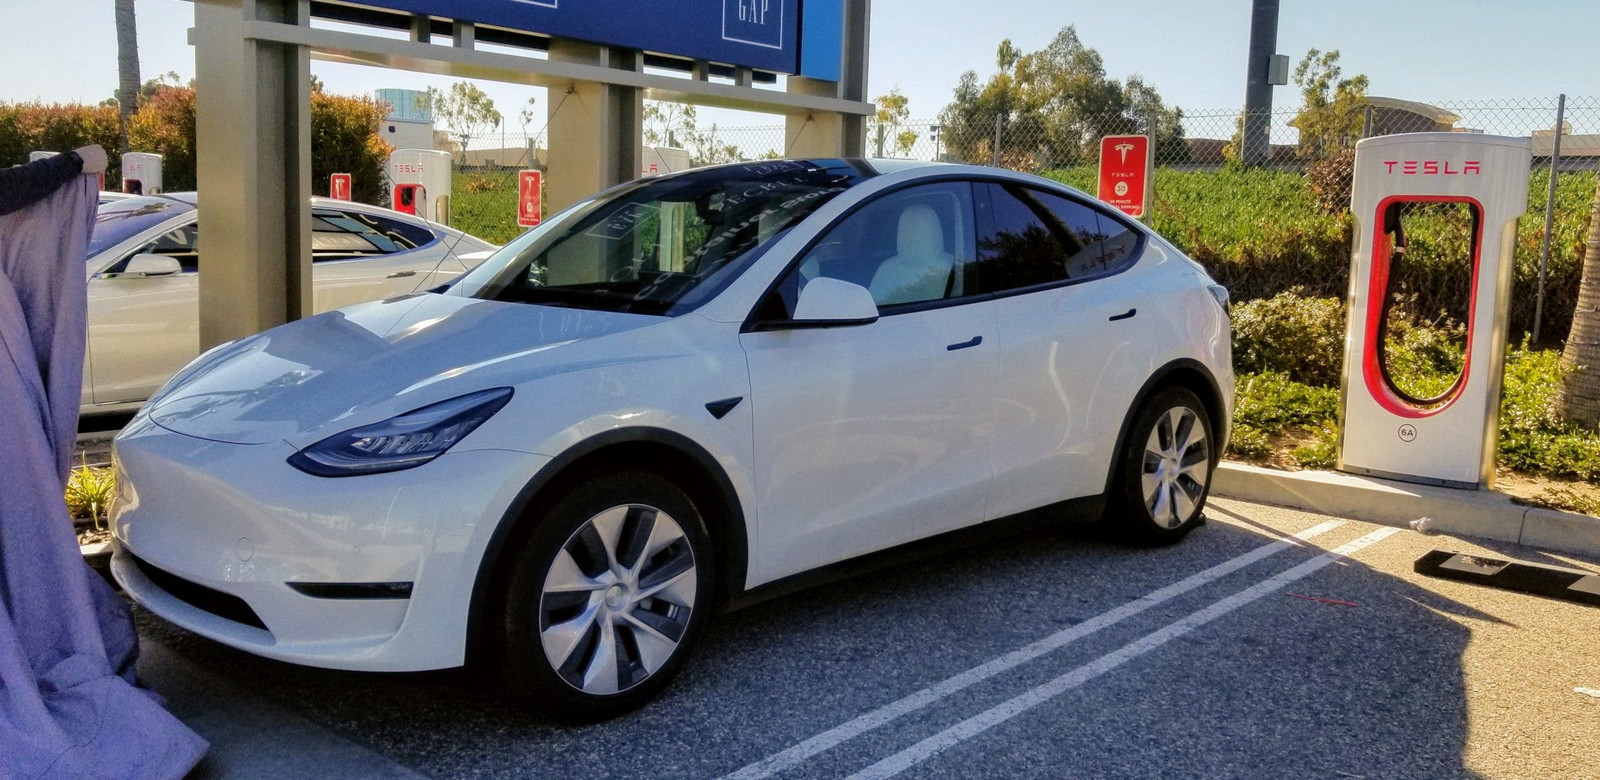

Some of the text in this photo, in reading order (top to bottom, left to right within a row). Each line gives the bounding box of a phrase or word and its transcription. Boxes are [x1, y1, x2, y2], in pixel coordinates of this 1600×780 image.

[739, 0, 768, 24] GAP
[395, 164, 423, 172] TESLA
[1384, 161, 1480, 174] TESLA
[1401, 428, 1414, 436] 6A
